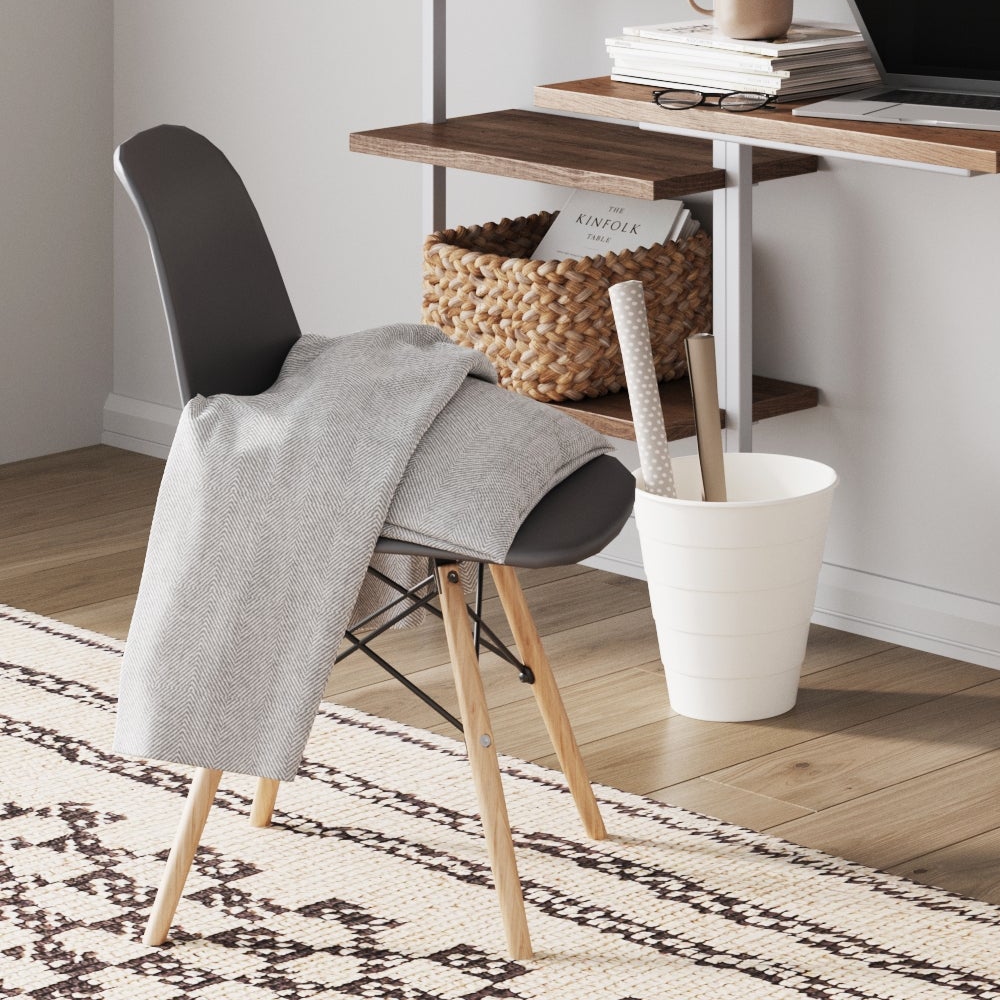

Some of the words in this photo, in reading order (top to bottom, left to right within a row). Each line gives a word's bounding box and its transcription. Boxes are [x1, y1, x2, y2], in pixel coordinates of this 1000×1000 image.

[608, 206, 625, 214] THE
[575, 213, 641, 235] KINFOLK
[586, 233, 612, 243] TABLE
